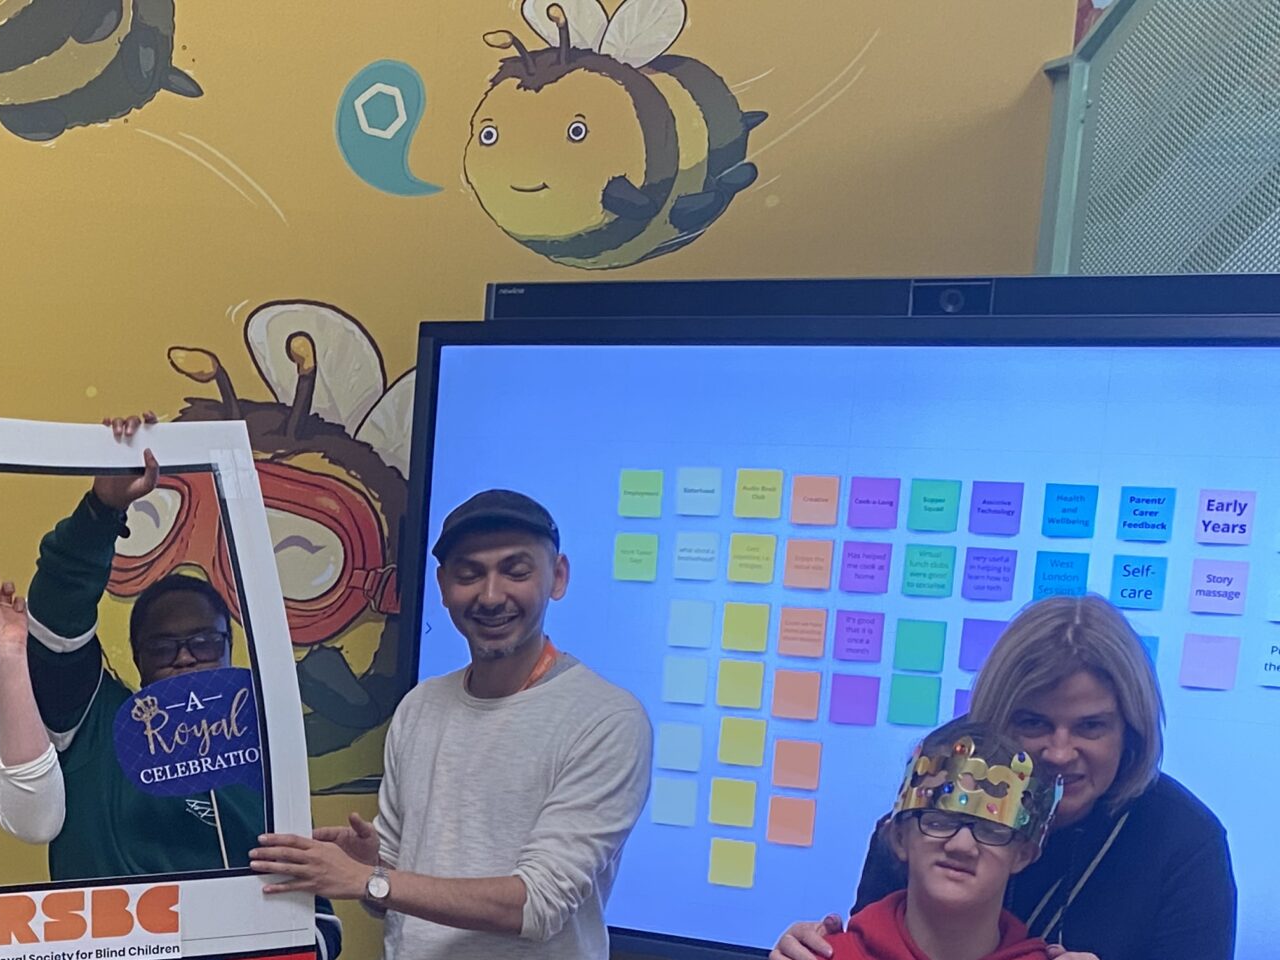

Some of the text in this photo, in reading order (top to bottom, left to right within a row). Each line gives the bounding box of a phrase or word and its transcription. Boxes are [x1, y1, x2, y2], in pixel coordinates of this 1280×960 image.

[1129, 495, 1167, 505] Parent/
[1132, 508, 1159, 517] Carer
[1206, 499, 1248, 516] Early
[1047, 517, 1090, 527] Wellbeing
[1122, 520, 1167, 530] Feedback
[1201, 520, 1247, 534] Years
[1049, 559, 1074, 569] West
[1042, 572, 1079, 581] London
[1122, 564, 1156, 578] Self-
[1206, 574, 1234, 587] Story
[1120, 588, 1153, 600] care
[1195, 588, 1241, 601] massage
[186, 691, 205, 712] A
[143, 687, 250, 757] Royal
[140, 746, 262, 785] CELEBRATIO
[95, 947, 126, 959] Blind
[128, 943, 181, 957] Children
